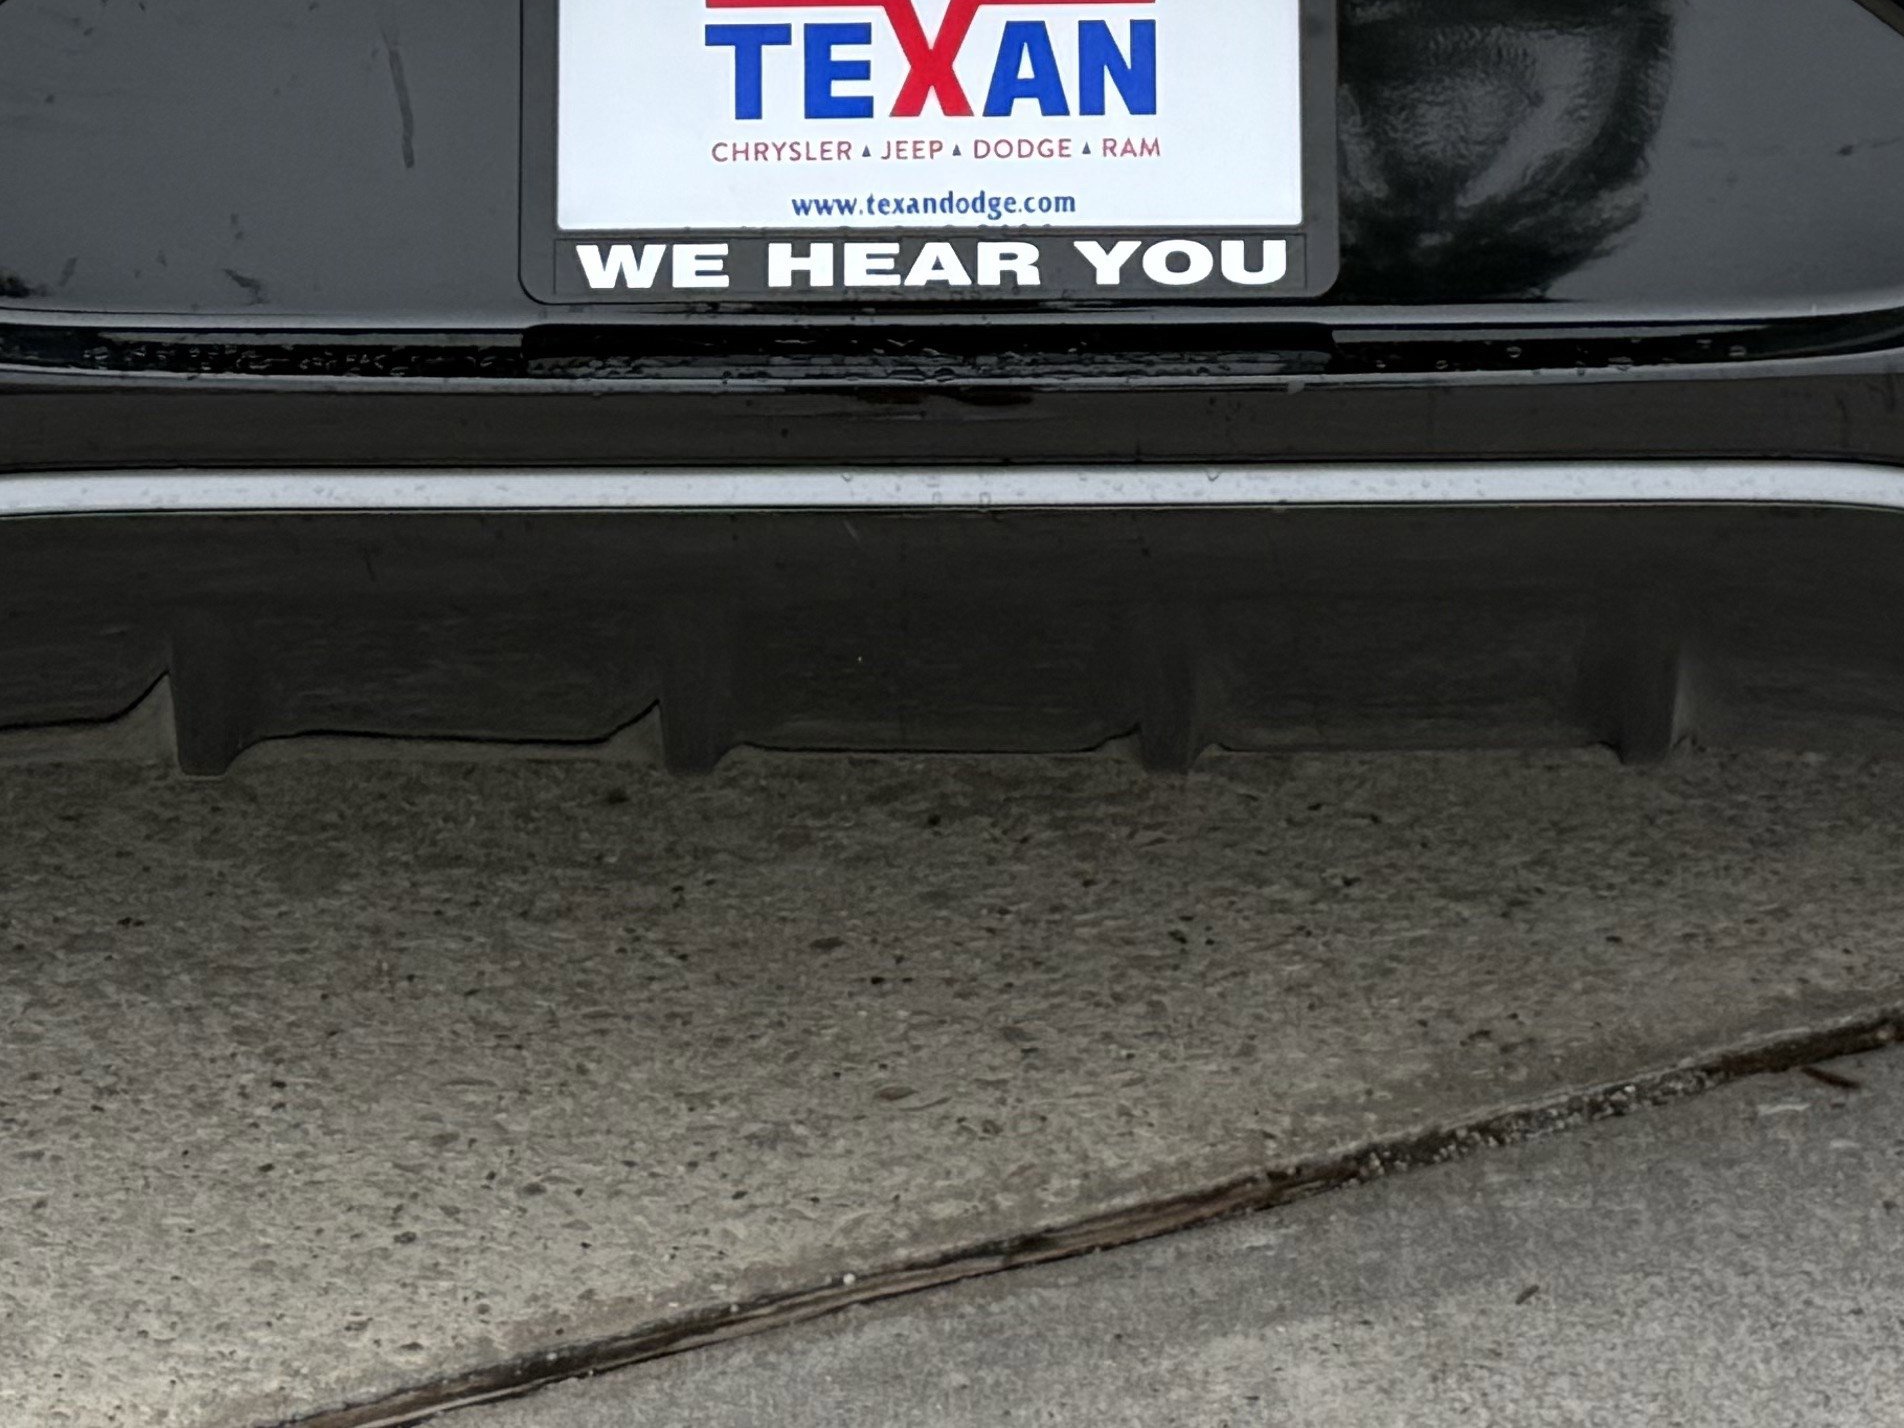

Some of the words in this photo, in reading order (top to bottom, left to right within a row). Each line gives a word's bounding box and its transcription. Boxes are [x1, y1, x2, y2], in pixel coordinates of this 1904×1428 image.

[711, 141, 853, 164] CHRYSLER
[880, 139, 944, 161] JEEP
[973, 138, 1073, 159] DODGE
[1101, 136, 1162, 158] RAM
[791, 190, 1077, 221] www.texandodge.com
[575, 242, 730, 290] WE
[766, 240, 1043, 289] HEAR
[1073, 238, 1289, 287] YOU
